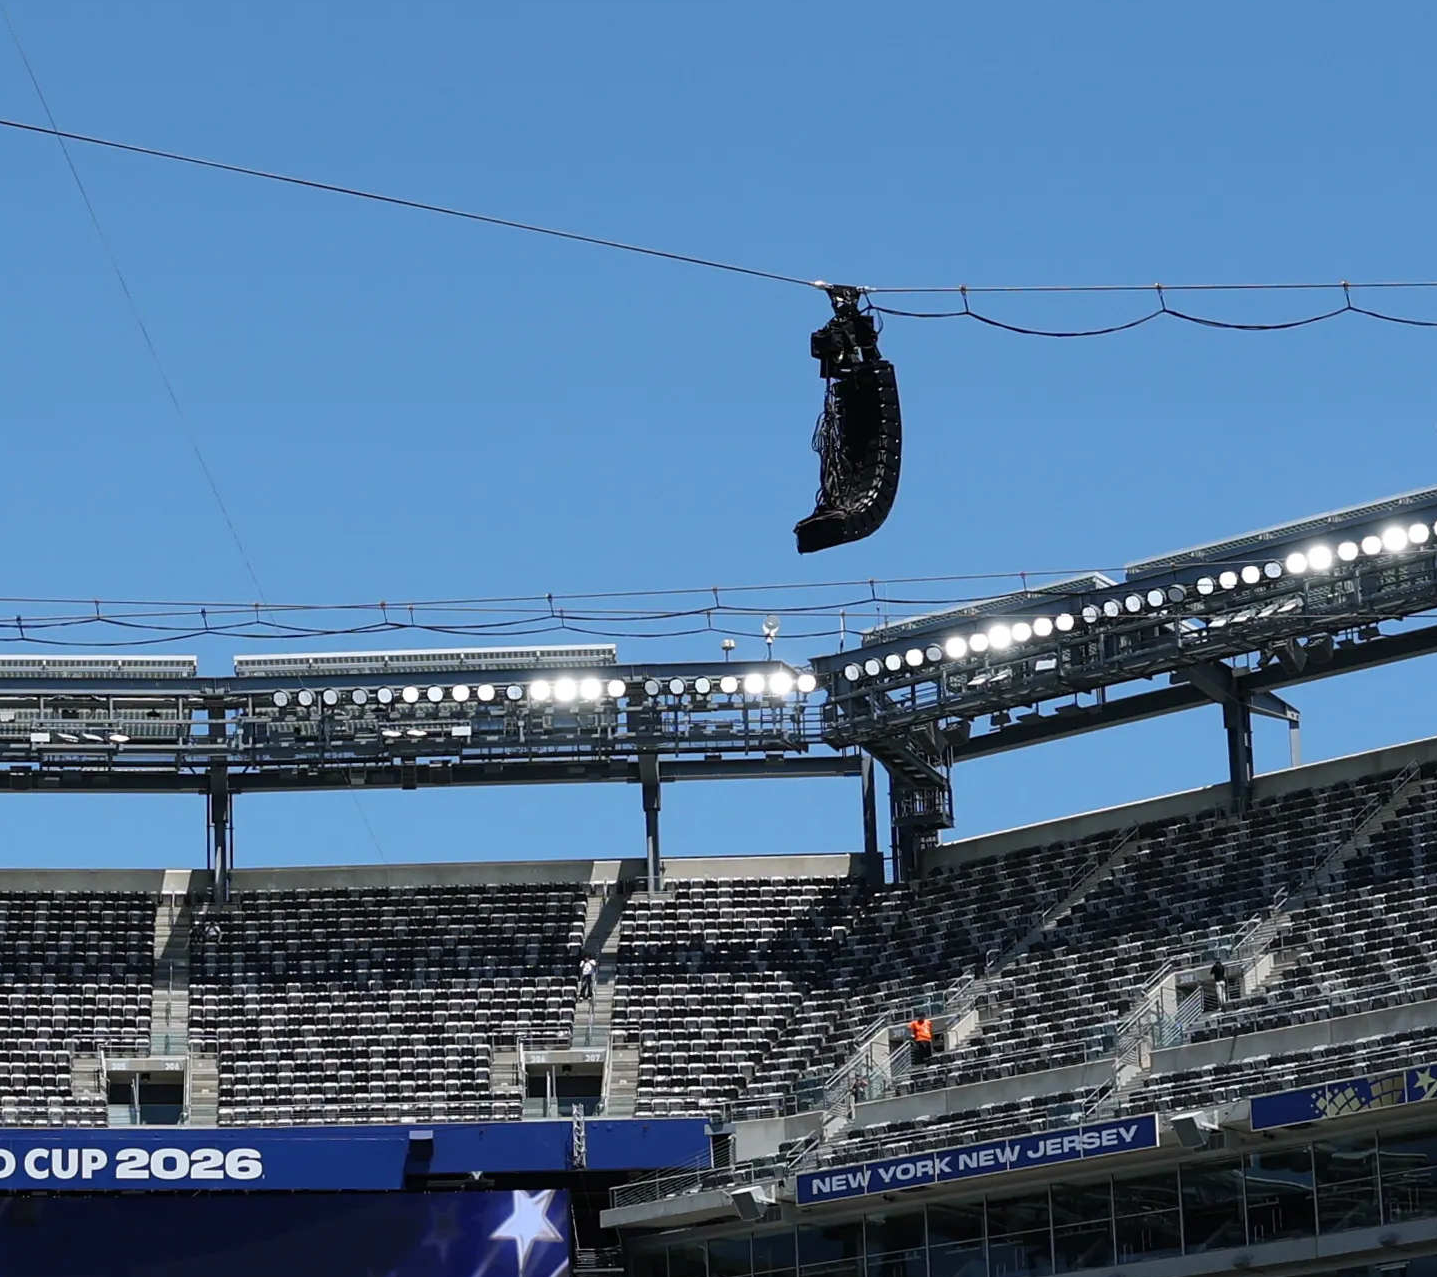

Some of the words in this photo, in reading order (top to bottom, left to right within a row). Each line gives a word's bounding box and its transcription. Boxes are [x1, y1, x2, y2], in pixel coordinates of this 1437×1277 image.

[24, 1147, 108, 1180] CUP
[116, 1147, 262, 1180] 2026
[811, 1167, 869, 1197] NEW
[877, 1157, 953, 1186] YORK
[958, 1144, 1021, 1177] NEW
[1027, 1124, 1140, 1161] JERSEY
